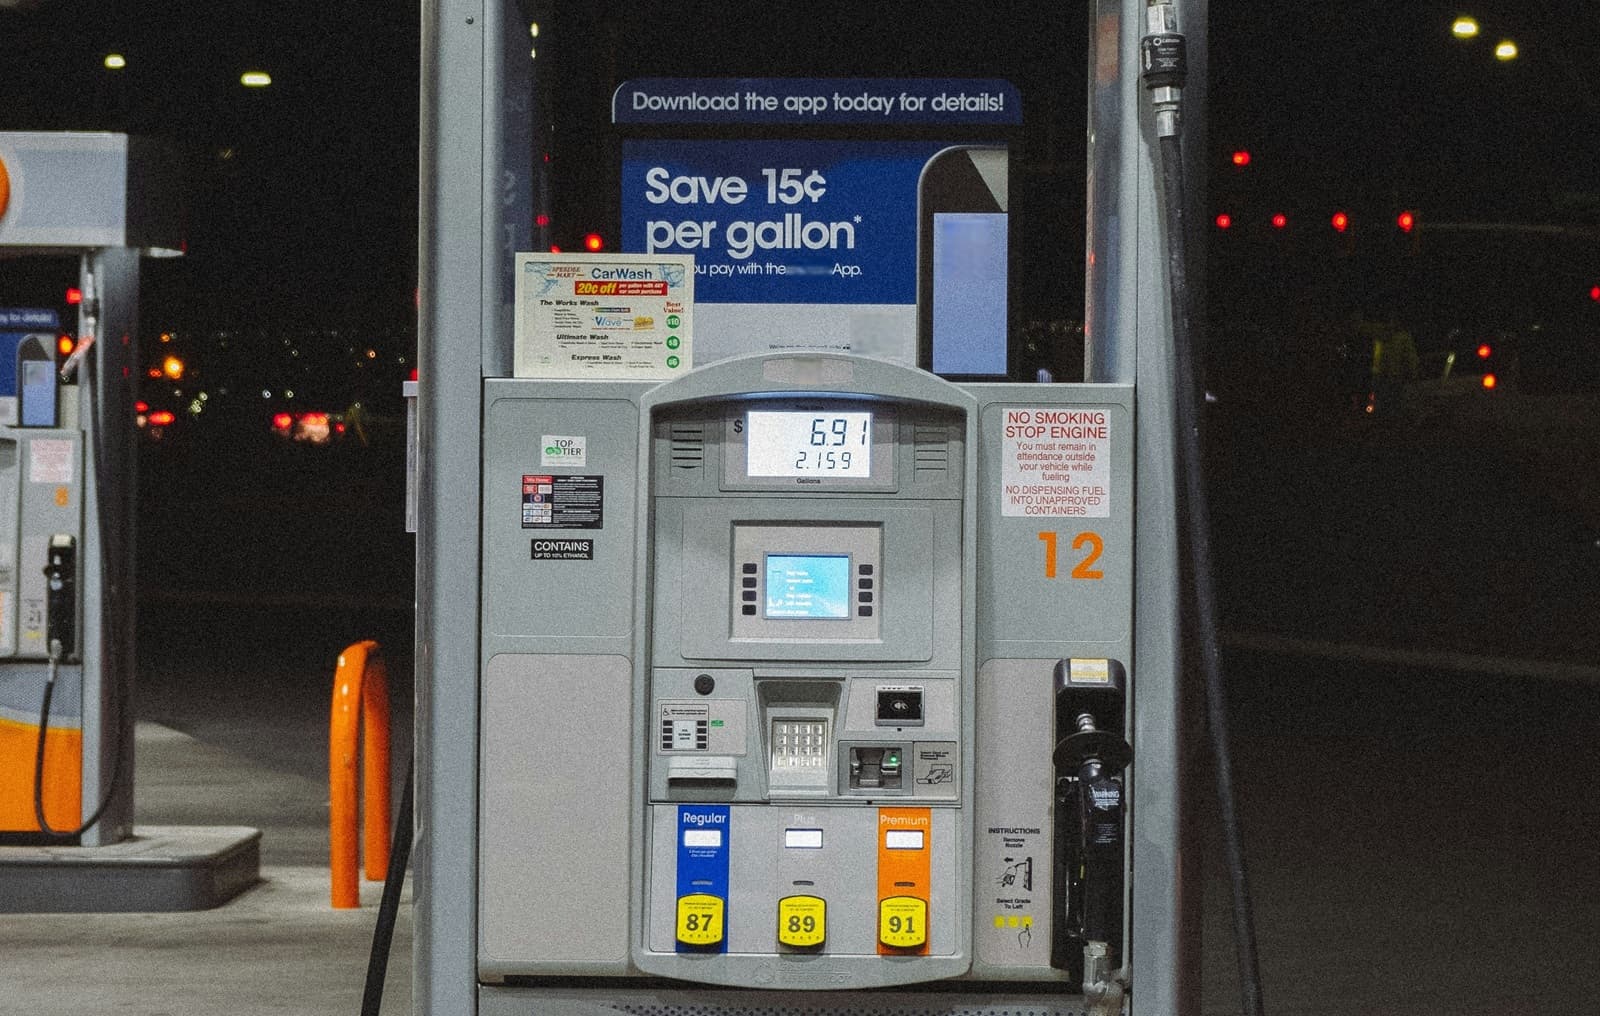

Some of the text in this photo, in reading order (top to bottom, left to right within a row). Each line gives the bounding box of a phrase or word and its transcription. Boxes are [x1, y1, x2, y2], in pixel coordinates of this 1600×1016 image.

[632, 92, 1004, 115] Download the app today for details!
[646, 167, 826, 204] Save 15¢
[646, 220, 717, 254] per
[591, 268, 652, 279] CarWash
[694, 262, 862, 279] ou pay with the App.
[600, 282, 617, 294] off
[1008, 412, 1105, 424] NO SMOKING
[734, 420, 743, 434] $
[810, 419, 867, 446] 6.91
[1006, 426, 1107, 439] STOP ENGINE
[1017, 442, 1033, 451] You
[1036, 443, 1056, 451] must
[796, 452, 851, 469] 2.159
[1017, 452, 1096, 461] attendance outside
[1019, 463, 1093, 472] your vehicle while
[1042, 473, 1070, 482] fueling
[1006, 486, 1106, 495] NO DISPENSING FUEL
[1011, 496, 1100, 505] INTO UNAPPROVED
[1025, 506, 1086, 515] CONTAINERS
[535, 541, 589, 551] CONTAINS
[1038, 531, 1104, 579] 12
[683, 812, 726, 826] Regular
[793, 814, 815, 824] Plus
[880, 815, 928, 825] Premium
[686, 914, 713, 931] 87
[788, 915, 816, 933] 89
[889, 916, 915, 933] 91
